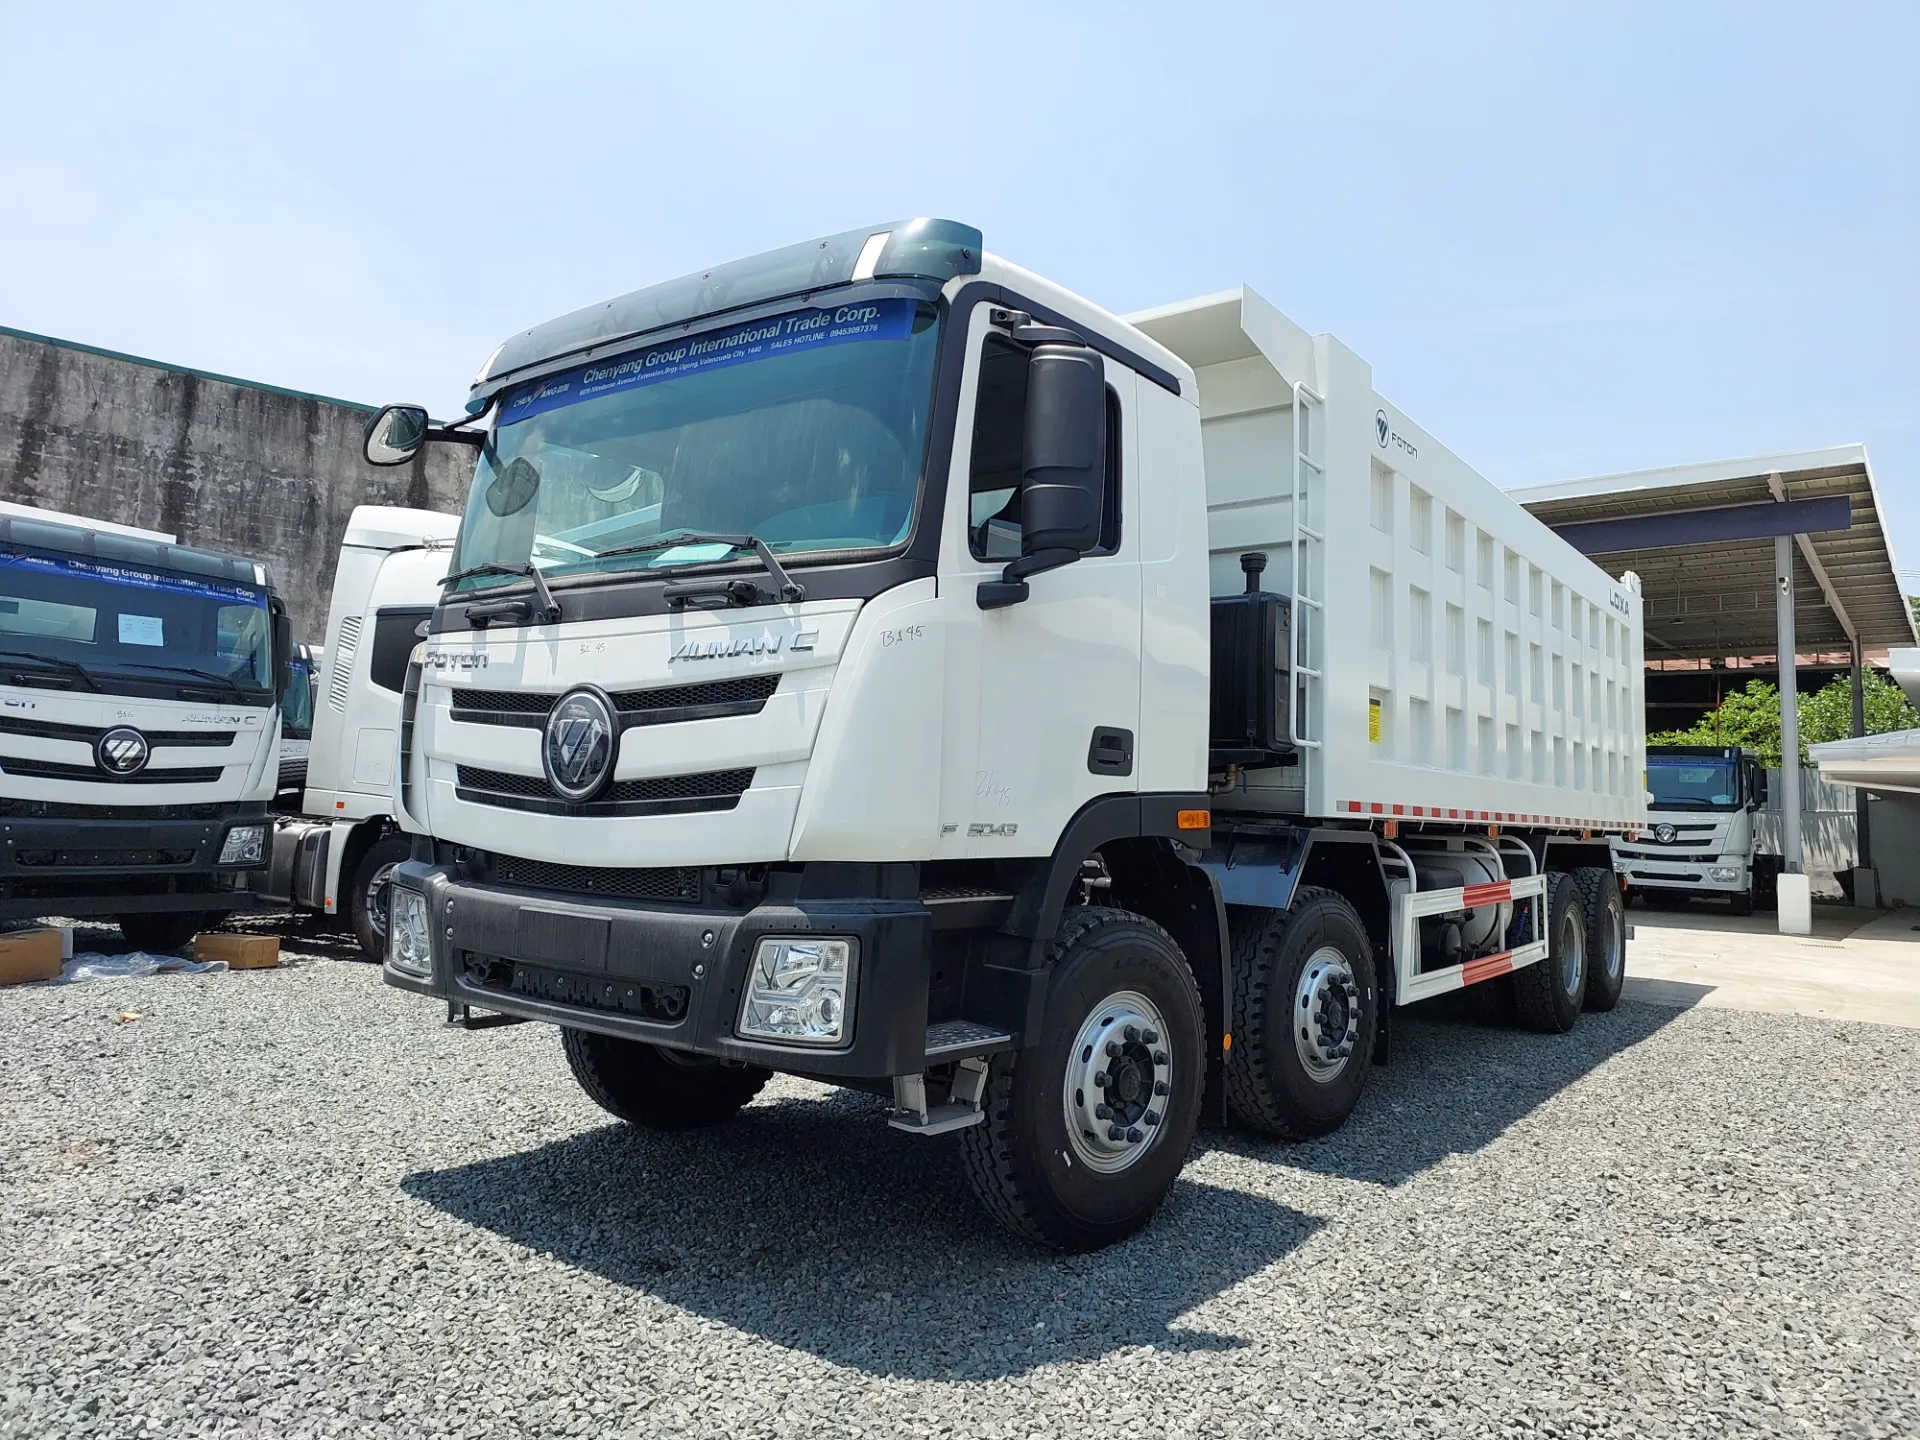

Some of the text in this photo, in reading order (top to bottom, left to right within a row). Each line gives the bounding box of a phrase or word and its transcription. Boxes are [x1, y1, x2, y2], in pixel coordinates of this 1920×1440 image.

[584, 306, 881, 384] Chenyang Group International Trade Corp.
[617, 376, 636, 386] Avenue
[732, 348, 745, 359] City
[770, 338, 793, 350] SALES
[68, 560, 119, 577] Chenyang
[121, 568, 151, 581] Group
[153, 574, 209, 590] International
[212, 582, 235, 594] Trade
[1609, 588, 1630, 619] LOXA
[668, 629, 820, 664] AUMAN C
[940, 822, 959, 838] F
